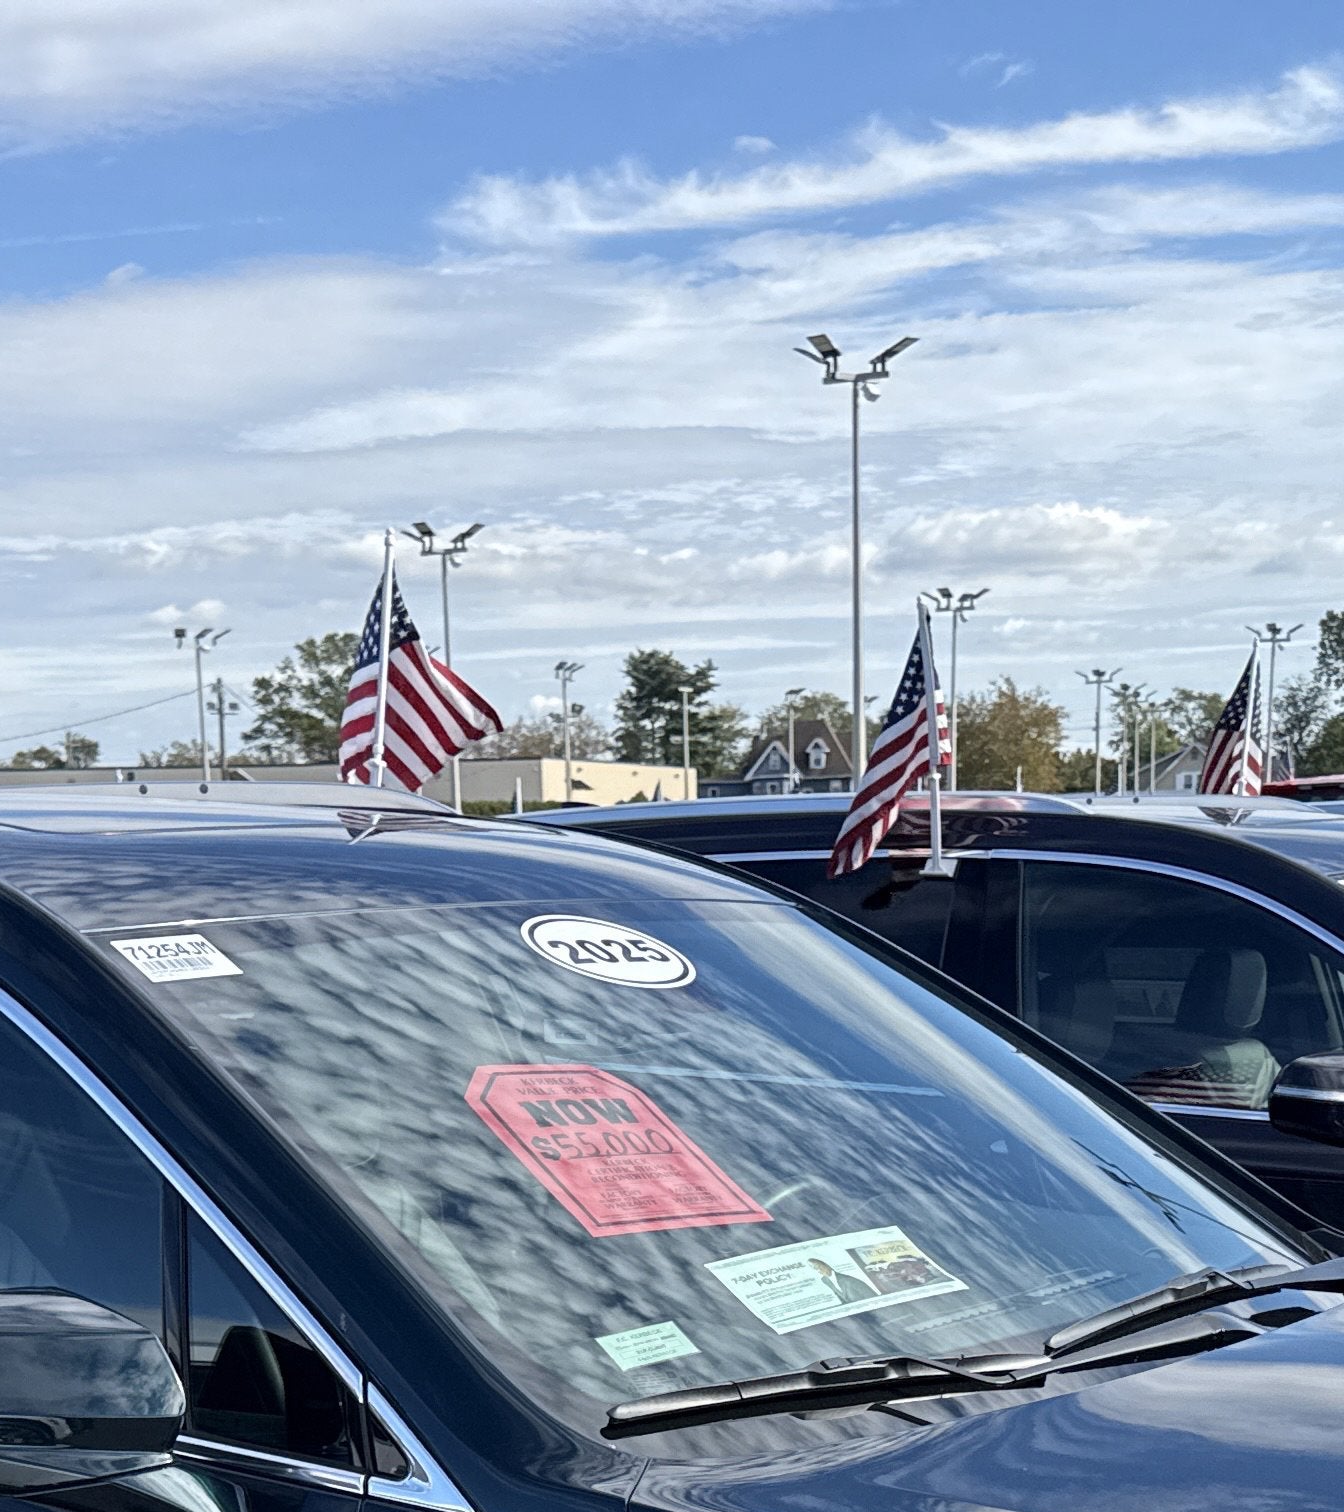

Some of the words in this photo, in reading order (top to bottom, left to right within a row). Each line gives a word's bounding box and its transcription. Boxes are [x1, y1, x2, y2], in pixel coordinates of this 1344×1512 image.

[547, 939, 671, 964] 2025
[561, 1086, 599, 1095] PRICE
[519, 1098, 640, 1128] NOW
[758, 1262, 806, 1277] EXCHANGE
[756, 1272, 792, 1287] POLICY
